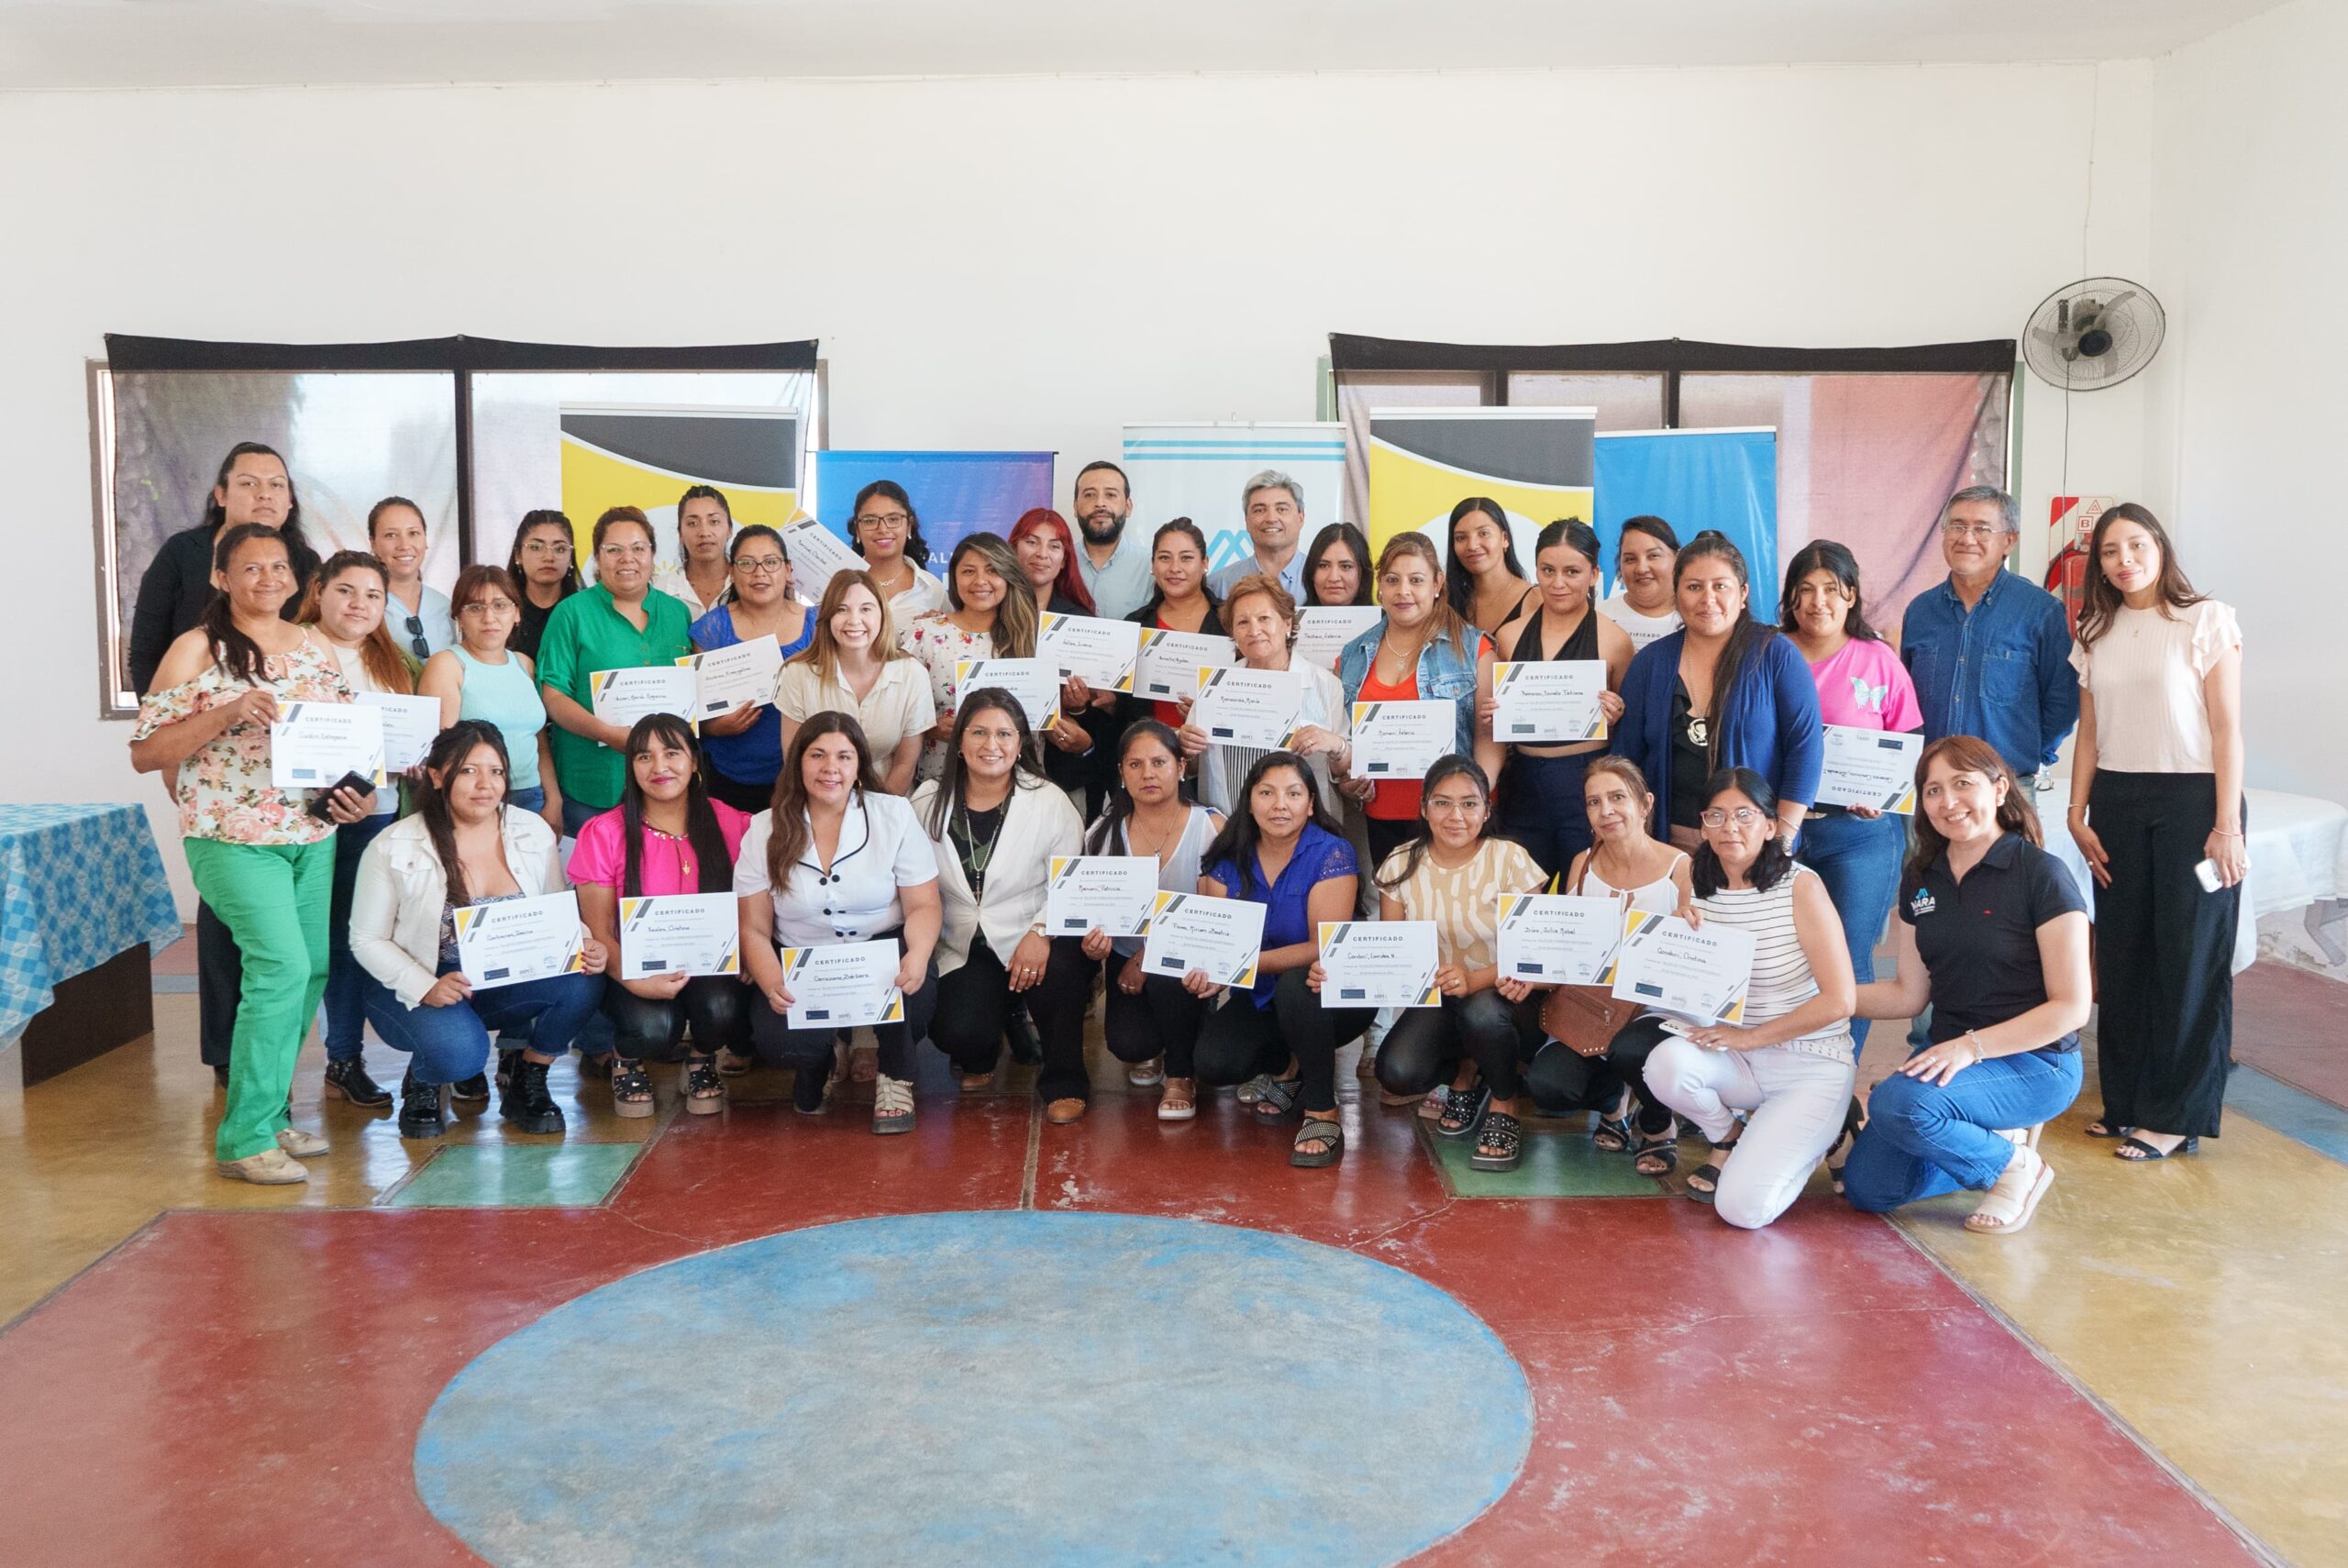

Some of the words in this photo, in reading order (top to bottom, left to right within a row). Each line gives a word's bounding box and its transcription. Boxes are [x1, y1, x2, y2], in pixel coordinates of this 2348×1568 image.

[2080, 519, 2090, 528] B
[810, 532, 843, 561] CERTIFICADO
[1068, 627, 1112, 636] CERTIFICADO
[1167, 642, 1209, 652] CERTIFICADO
[707, 653, 751, 668] CERTIFICADO
[620, 679, 666, 687] CERTIFICADO
[1226, 681, 1272, 690] CERTIFICADO
[305, 716, 353, 724] CERTIFICADO
[1831, 786, 1882, 797] CERTIFICADO
[492, 910, 544, 923] CERTIFICADO
[655, 908, 705, 916] CERTIFICADO
[1184, 908, 1232, 920] CERTIFICADO
[1534, 910, 1585, 918] CERTIFICADO
[1662, 931, 1718, 947] CERTIFICADO
[814, 956, 866, 966] CERTIFICADO
